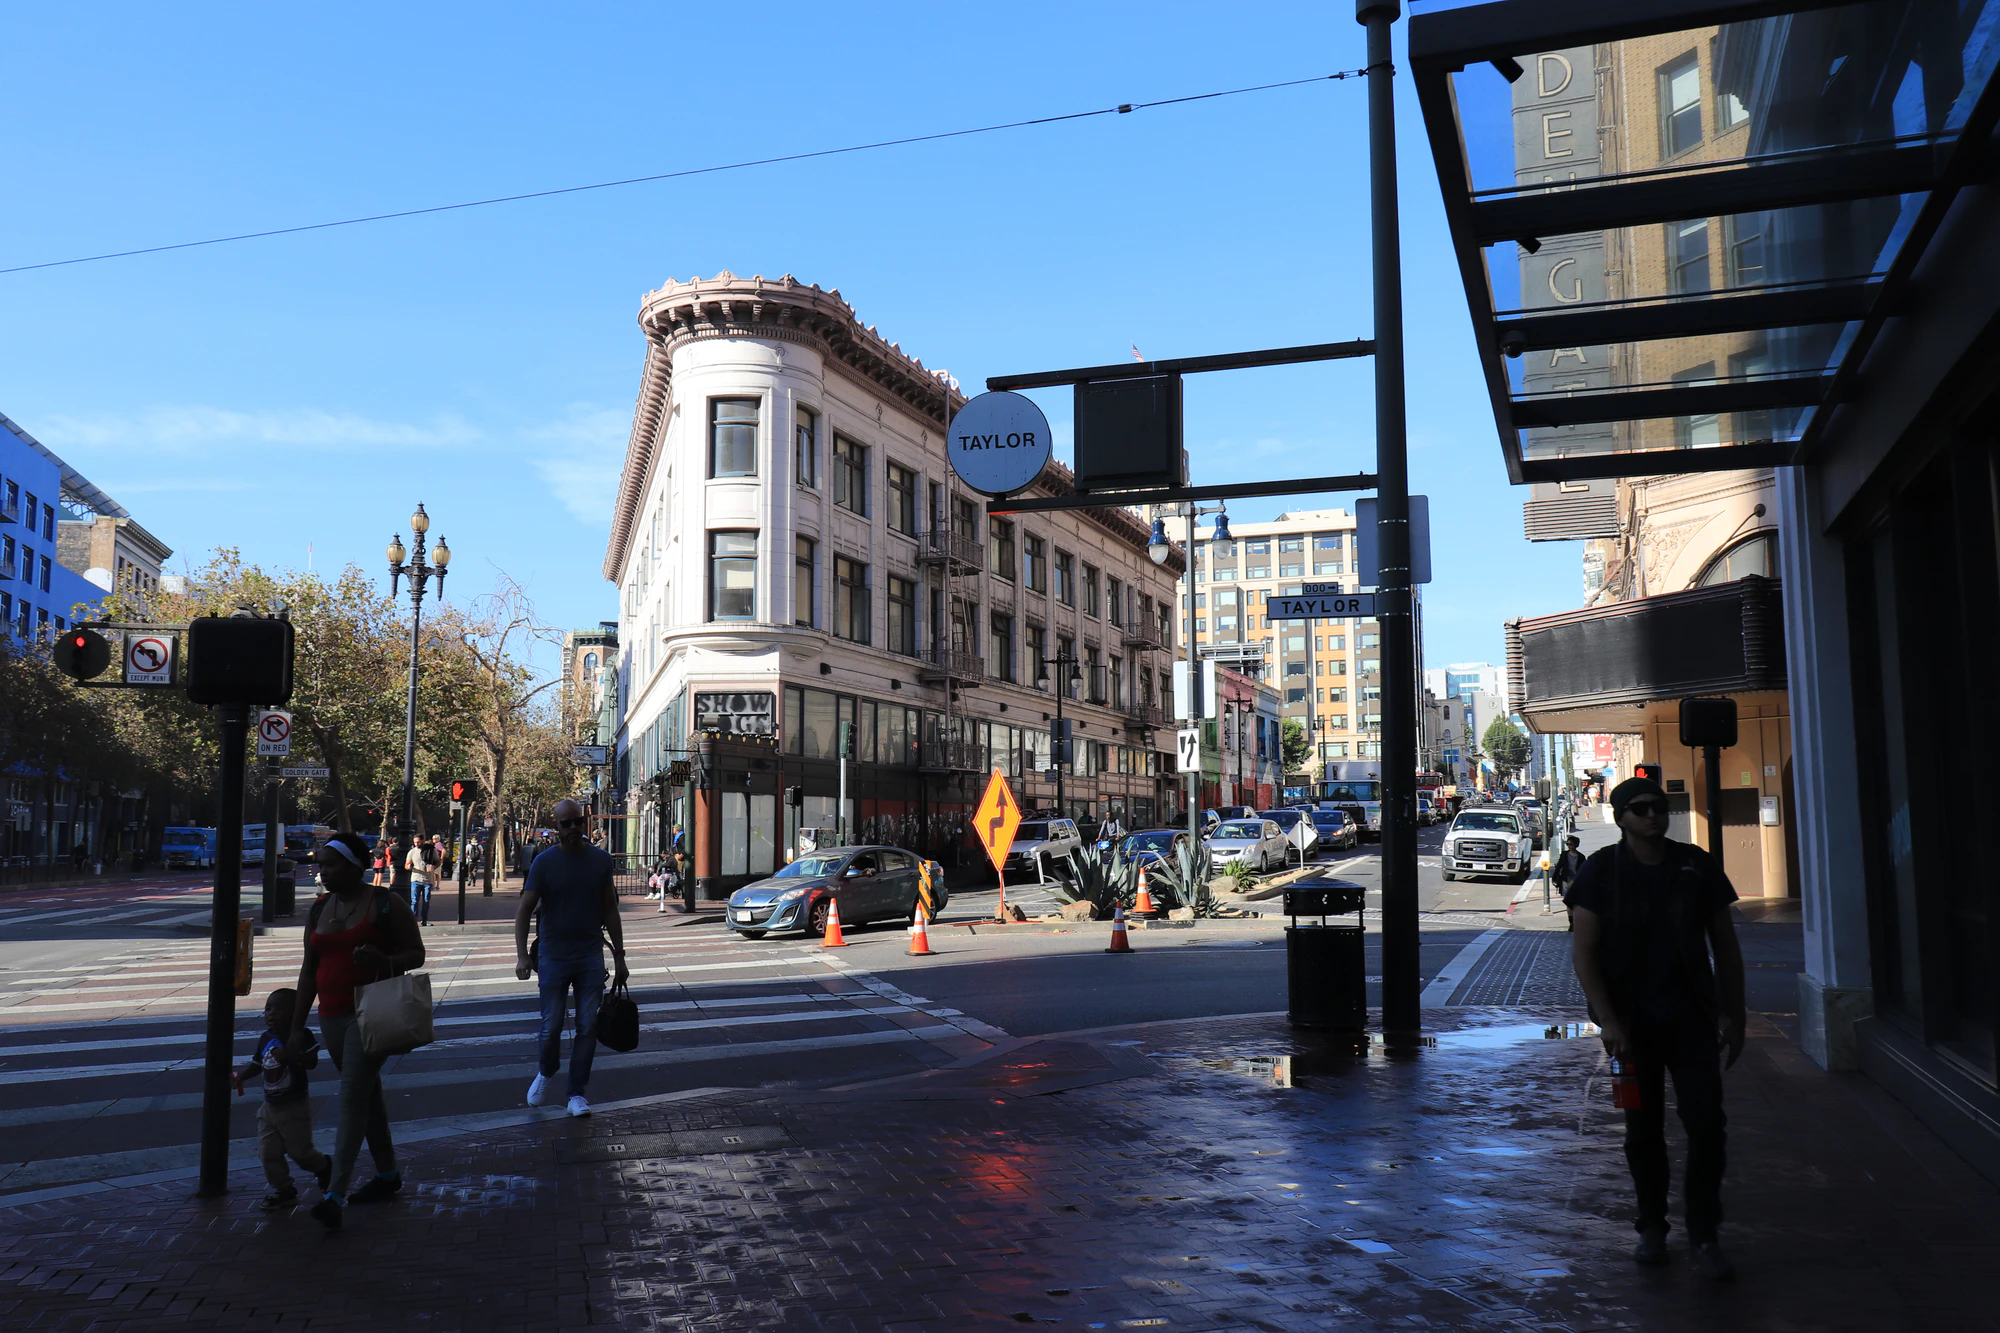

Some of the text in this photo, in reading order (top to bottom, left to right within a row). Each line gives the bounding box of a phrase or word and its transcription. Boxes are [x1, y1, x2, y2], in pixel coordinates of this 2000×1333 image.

[959, 432, 1035, 450] TAYLOR
[1305, 584, 1325, 592] 000
[1282, 599, 1360, 614] TAYLOR
[698, 695, 769, 712] SHOW
[699, 715, 770, 734] OGS
[671, 762, 690, 774] DOSA
